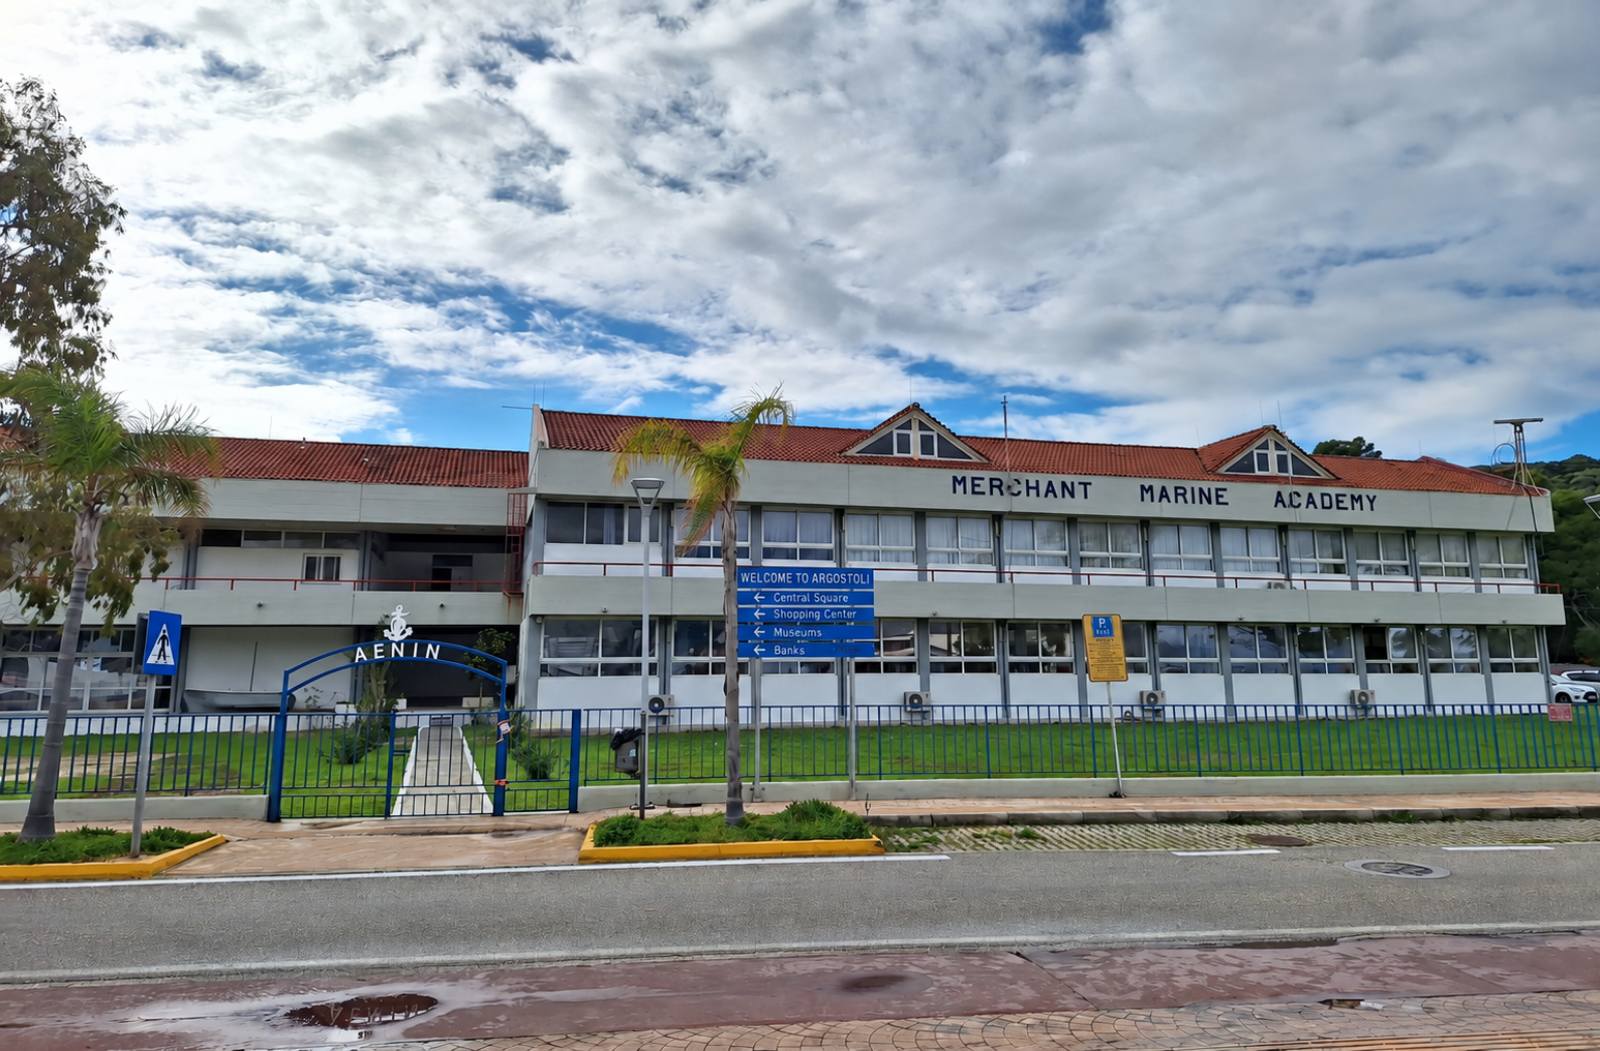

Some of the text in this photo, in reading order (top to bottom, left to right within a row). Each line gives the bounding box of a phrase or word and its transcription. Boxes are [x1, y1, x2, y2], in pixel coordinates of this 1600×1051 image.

[952, 475, 1377, 511] MERCHANT MARINE ACADEMY
[741, 572, 870, 584] WELCOME TO ARGOSTOLI
[773, 592, 849, 604] Central Square
[774, 608, 857, 620] Shopping Center
[774, 628, 822, 637] Museums
[354, 642, 440, 662] AENIN
[774, 645, 806, 655] Banks
